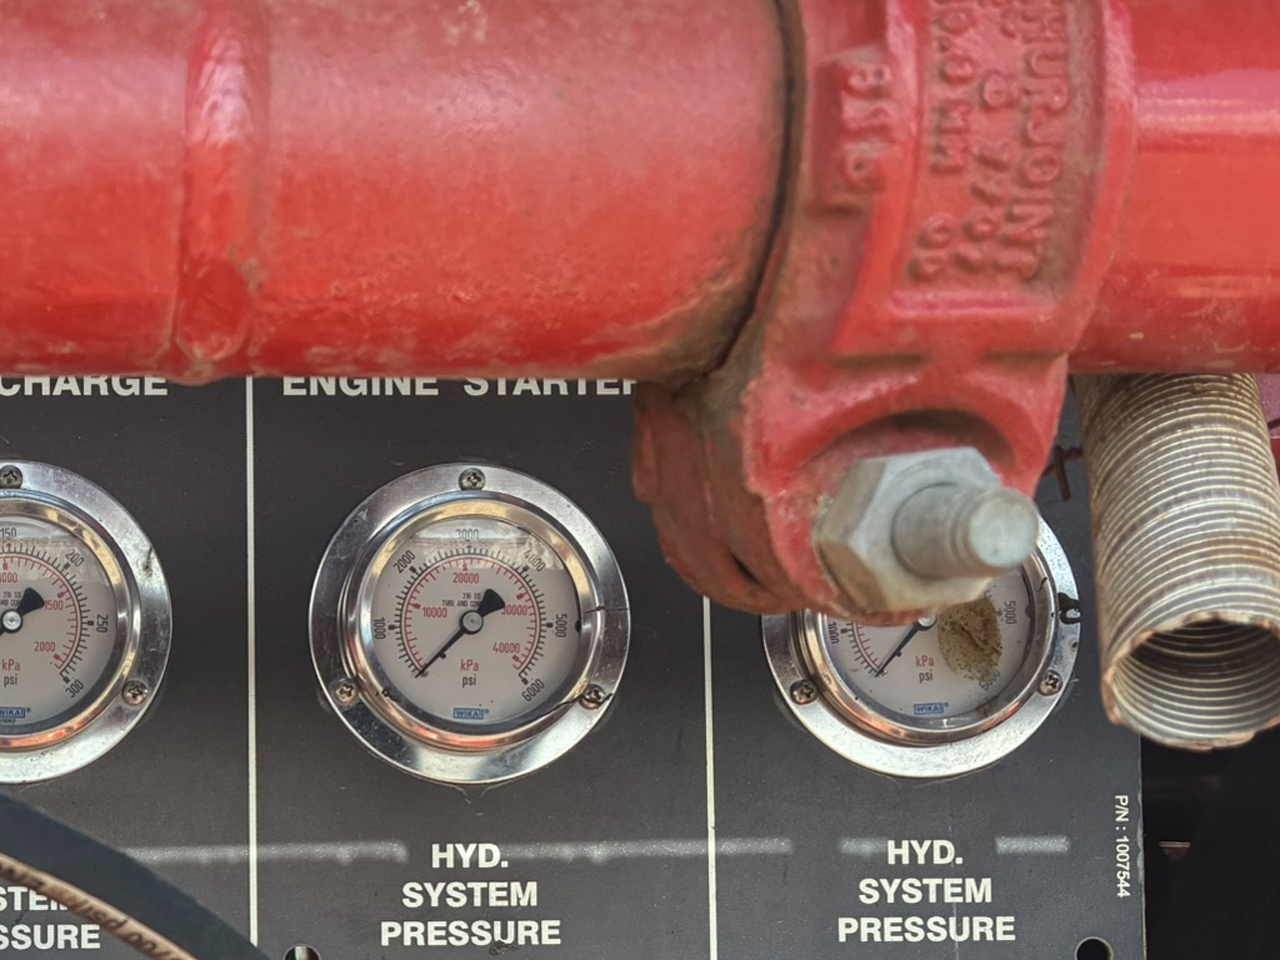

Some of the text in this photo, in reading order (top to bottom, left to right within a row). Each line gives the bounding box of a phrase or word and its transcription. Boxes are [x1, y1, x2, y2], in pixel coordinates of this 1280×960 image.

[993, 0, 1069, 283] HURJOINT
[282, 375, 439, 396] ENGINE
[0, 528, 17, 538] 150
[65, 549, 85, 567] 200
[392, 550, 416, 574] 2000
[523, 549, 546, 572] 4000
[0, 572, 18, 583] 1000
[452, 573, 480, 584] 20000
[44, 600, 64, 611] 1500
[422, 608, 448, 618] 10000
[1004, 600, 1016, 625] 5000
[96, 614, 109, 633] 250
[373, 616, 386, 640] 1000
[555, 613, 568, 638] 5000
[34, 642, 56, 652] 2000
[492, 642, 520, 653] 40000
[2, 659, 20, 671] kPa
[460, 659, 479, 672] kPa
[915, 655, 935, 668] kPa
[3, 674, 18, 687] psi
[462, 675, 477, 688] psi
[919, 669, 934, 684] psi
[65, 680, 85, 699] 300
[521, 678, 545, 702] 6000
[431, 843, 509, 869] HYD.
[887, 839, 964, 865] HYD.
[1116, 835, 1131, 898] 1007544
[401, 881, 538, 908] SYSTEM
[858, 877, 993, 904] SYSTEM
[381, 919, 562, 947] PRESSURE
[838, 916, 1016, 943] PRESSURE
